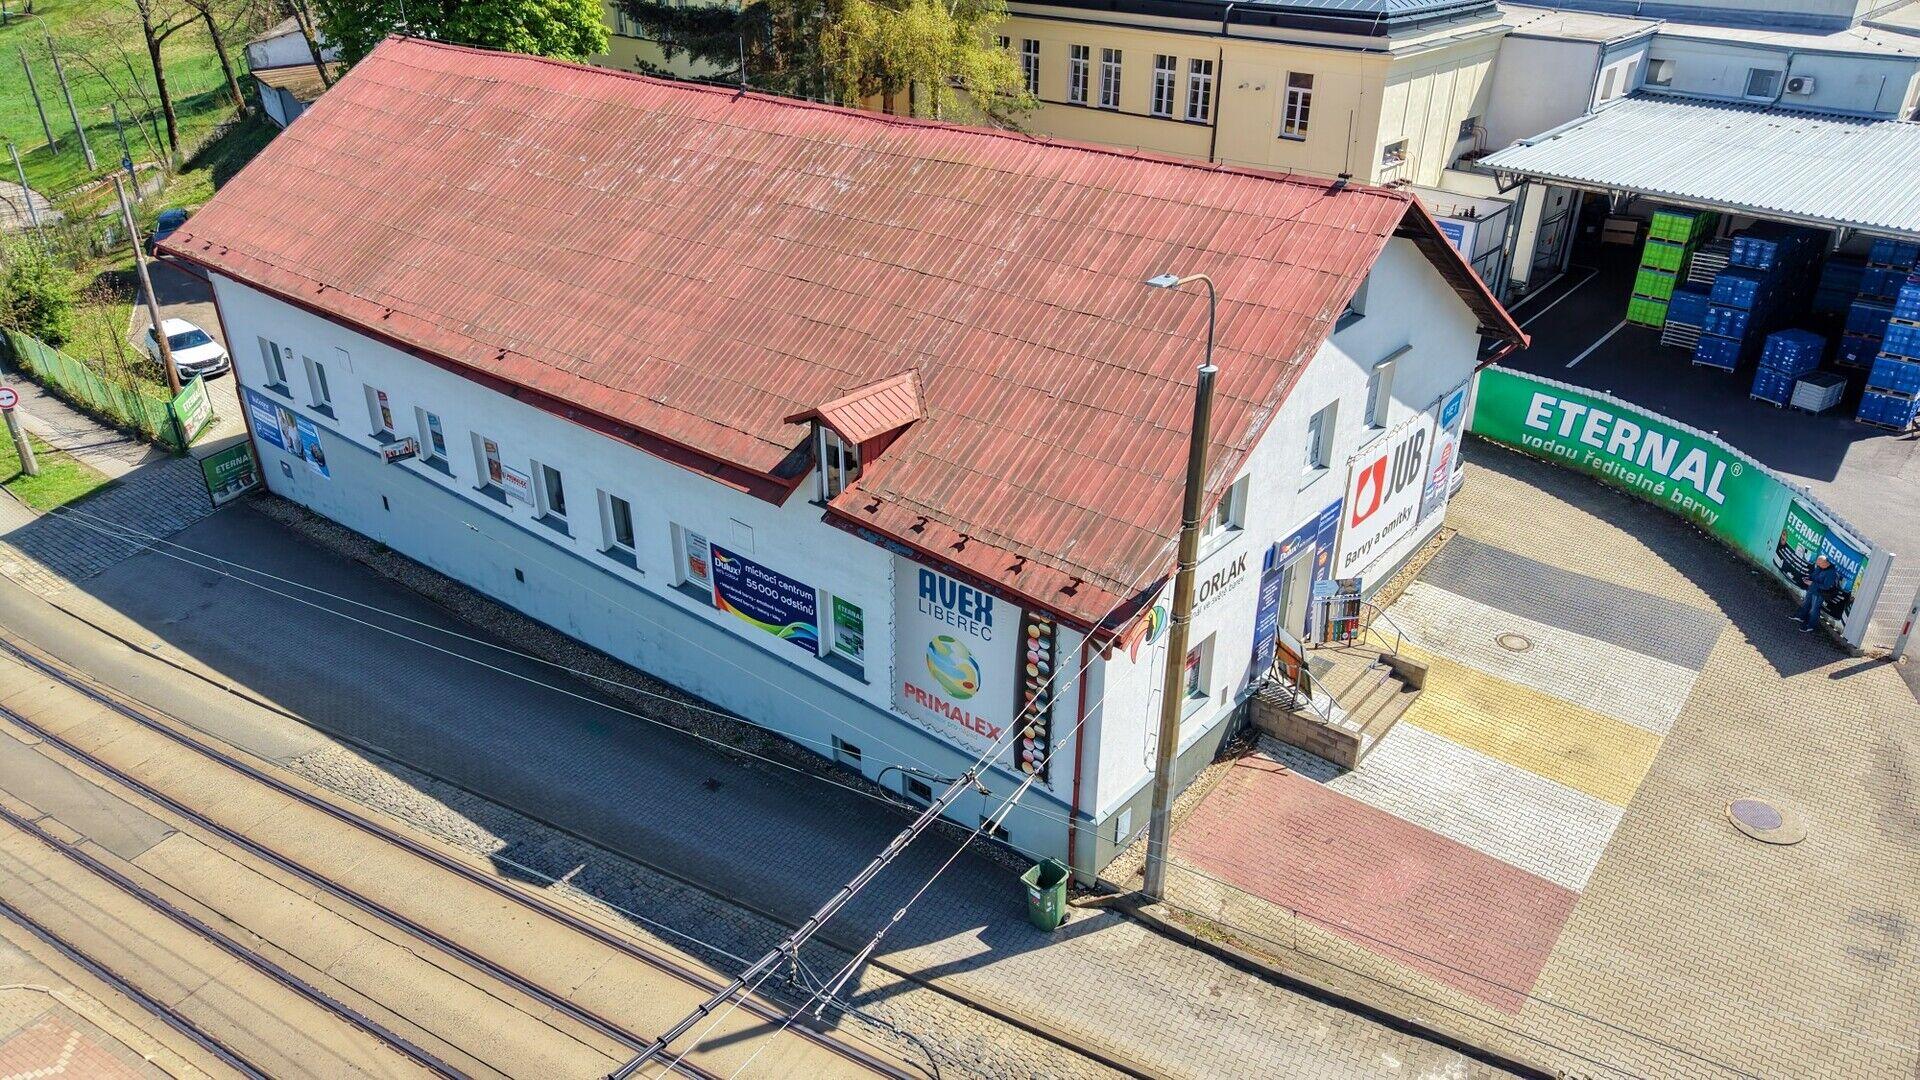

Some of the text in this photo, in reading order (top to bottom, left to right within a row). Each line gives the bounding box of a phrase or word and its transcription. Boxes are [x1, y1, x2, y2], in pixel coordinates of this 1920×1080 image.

[215, 454, 250, 475] ETERNA
[1383, 428, 1426, 504] JUB
[1524, 391, 1727, 505] ETERNAL
[1521, 433, 1720, 525] vodou ředitelné barvy
[1344, 538, 1375, 568] Barvy
[1374, 533, 1381, 545] a
[1381, 504, 1414, 540] omítky
[714, 557, 741, 576] Dulux
[778, 580, 813, 601] centrum
[1192, 551, 1248, 609] LORLAK
[780, 595, 814, 616] odstínů
[918, 568, 994, 627] AVEX
[918, 598, 992, 642] LIBEREC
[904, 681, 1002, 742] PRIMALEX
